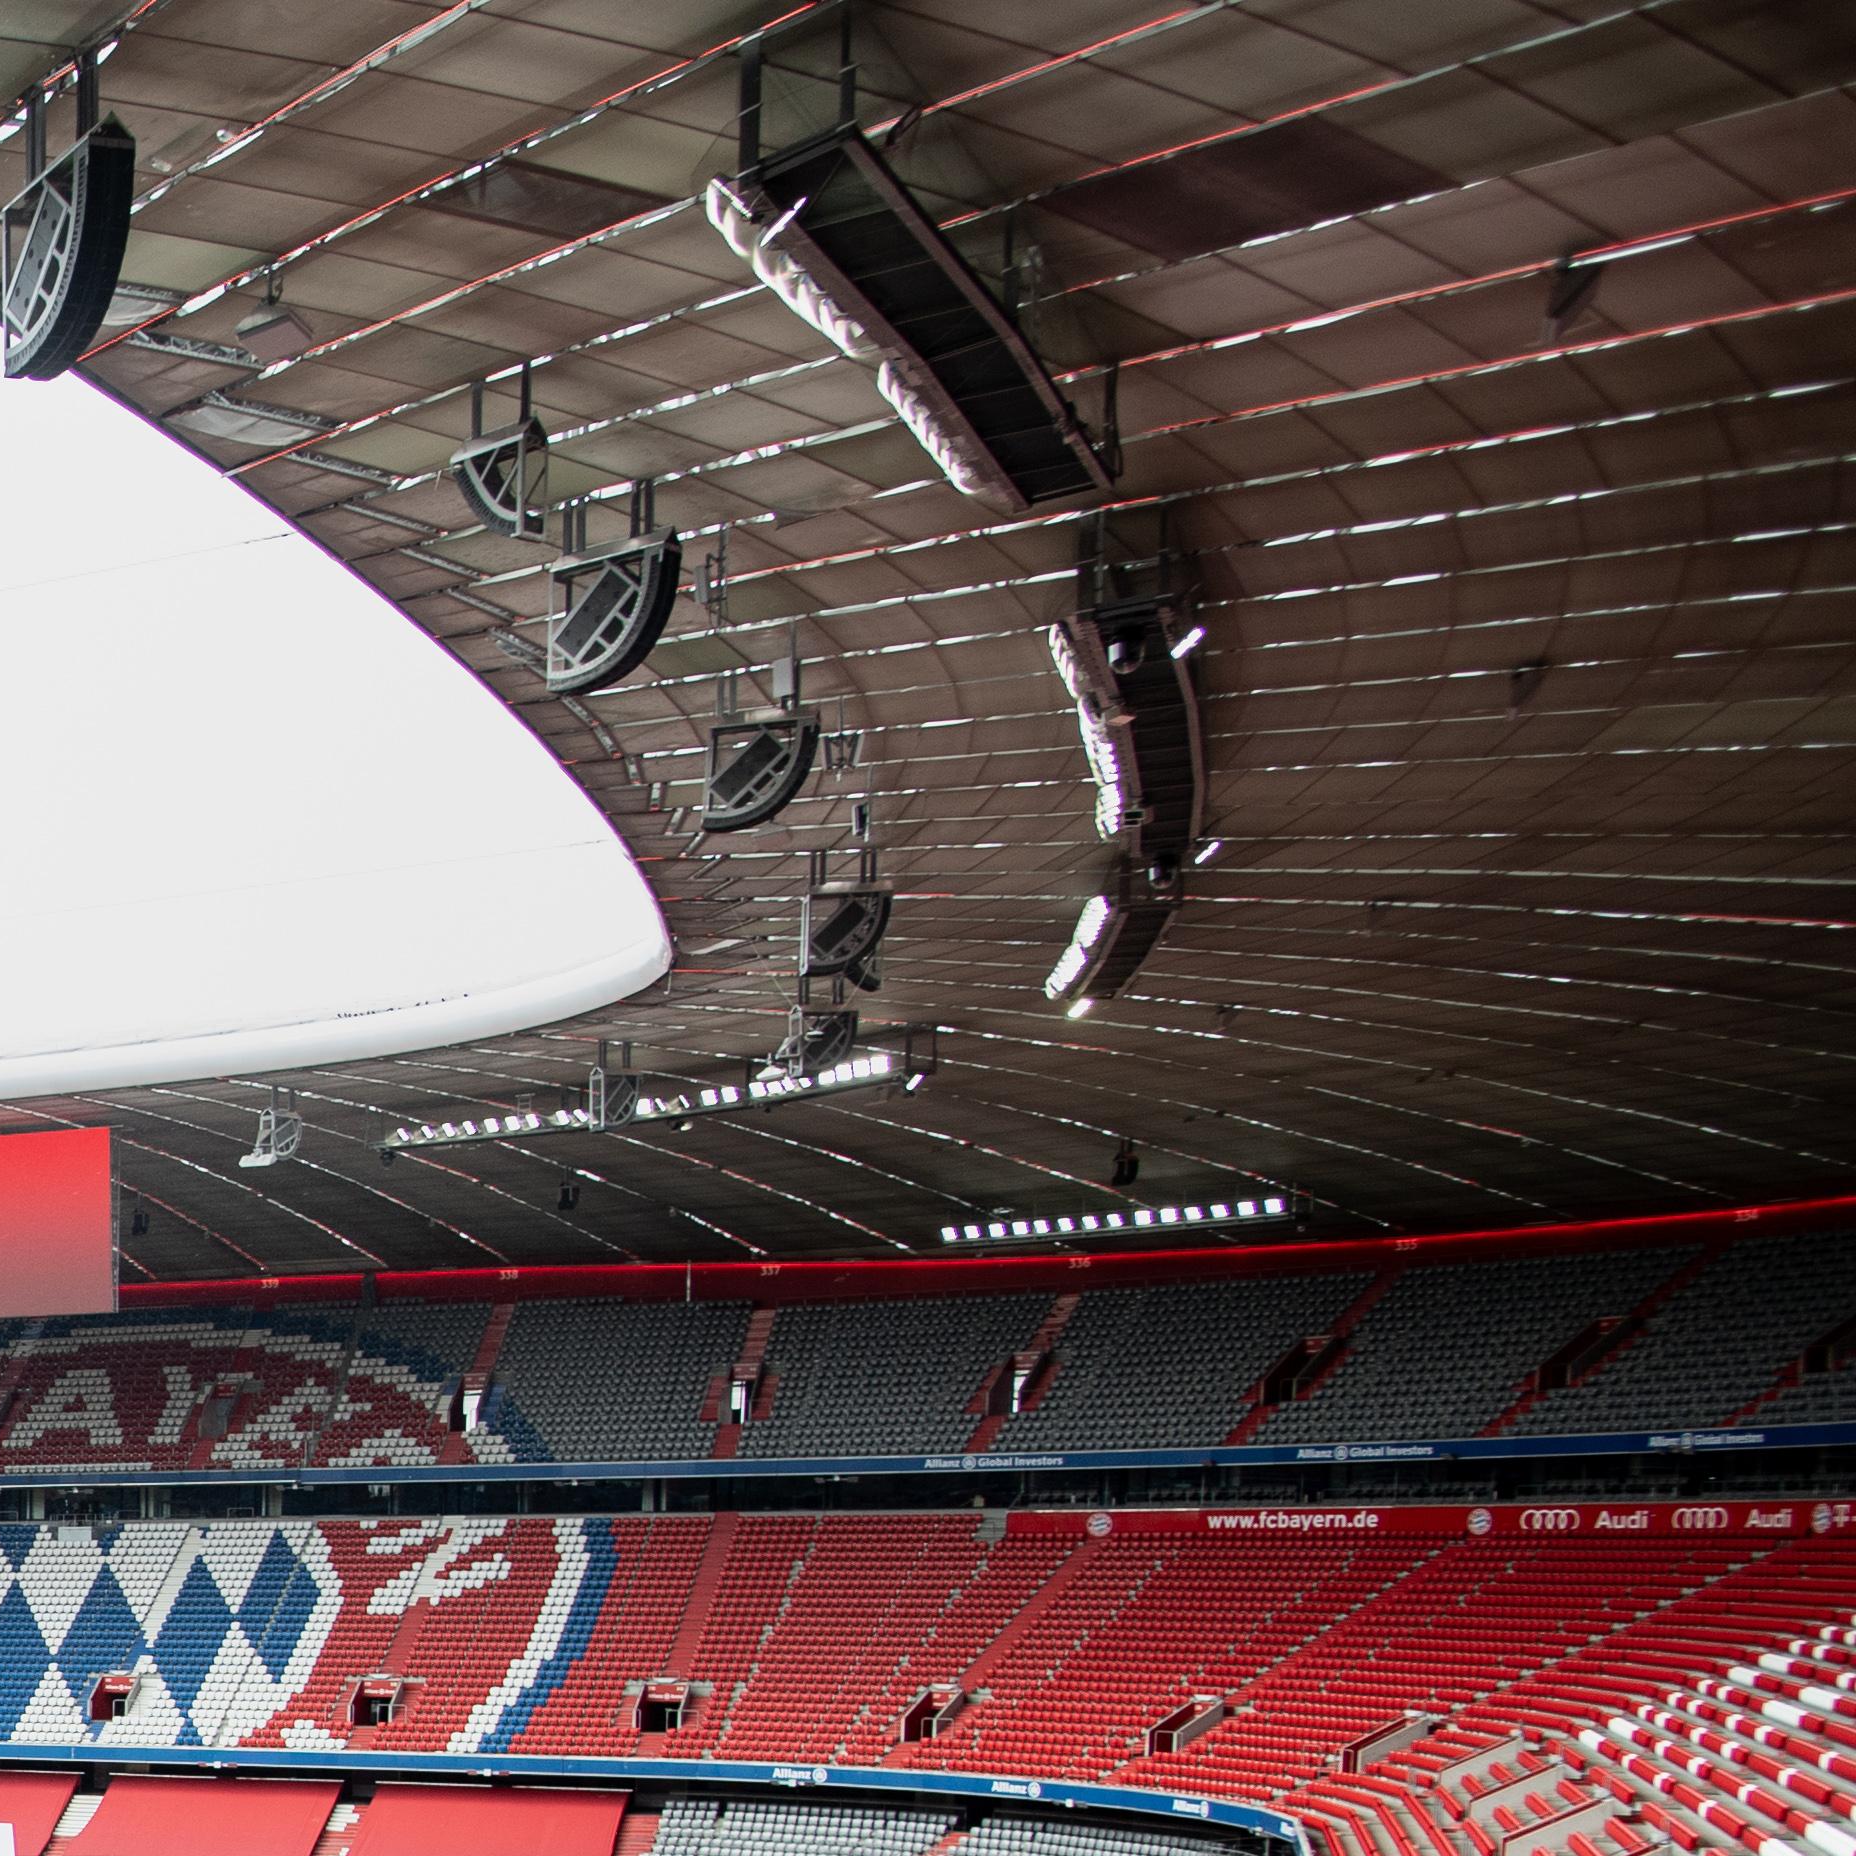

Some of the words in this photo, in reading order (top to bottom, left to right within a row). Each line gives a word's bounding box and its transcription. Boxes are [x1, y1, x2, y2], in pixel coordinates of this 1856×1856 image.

[760, 1265, 781, 1276] 337
[1296, 1447, 1333, 1459] Allianz
[1350, 1447, 1383, 1458] Global
[1385, 1445, 1434, 1456] Investors
[924, 1459, 961, 1469] Allianz
[978, 1457, 1013, 1468] Global
[1015, 1456, 1064, 1467] Investors
[1206, 1512, 1379, 1533] www.fcbayern.de
[1594, 1511, 1649, 1529] Audi
[1744, 1508, 1792, 1528] Audi
[773, 1767, 812, 1781] Allianz
[992, 1781, 1027, 1794] Allianz
